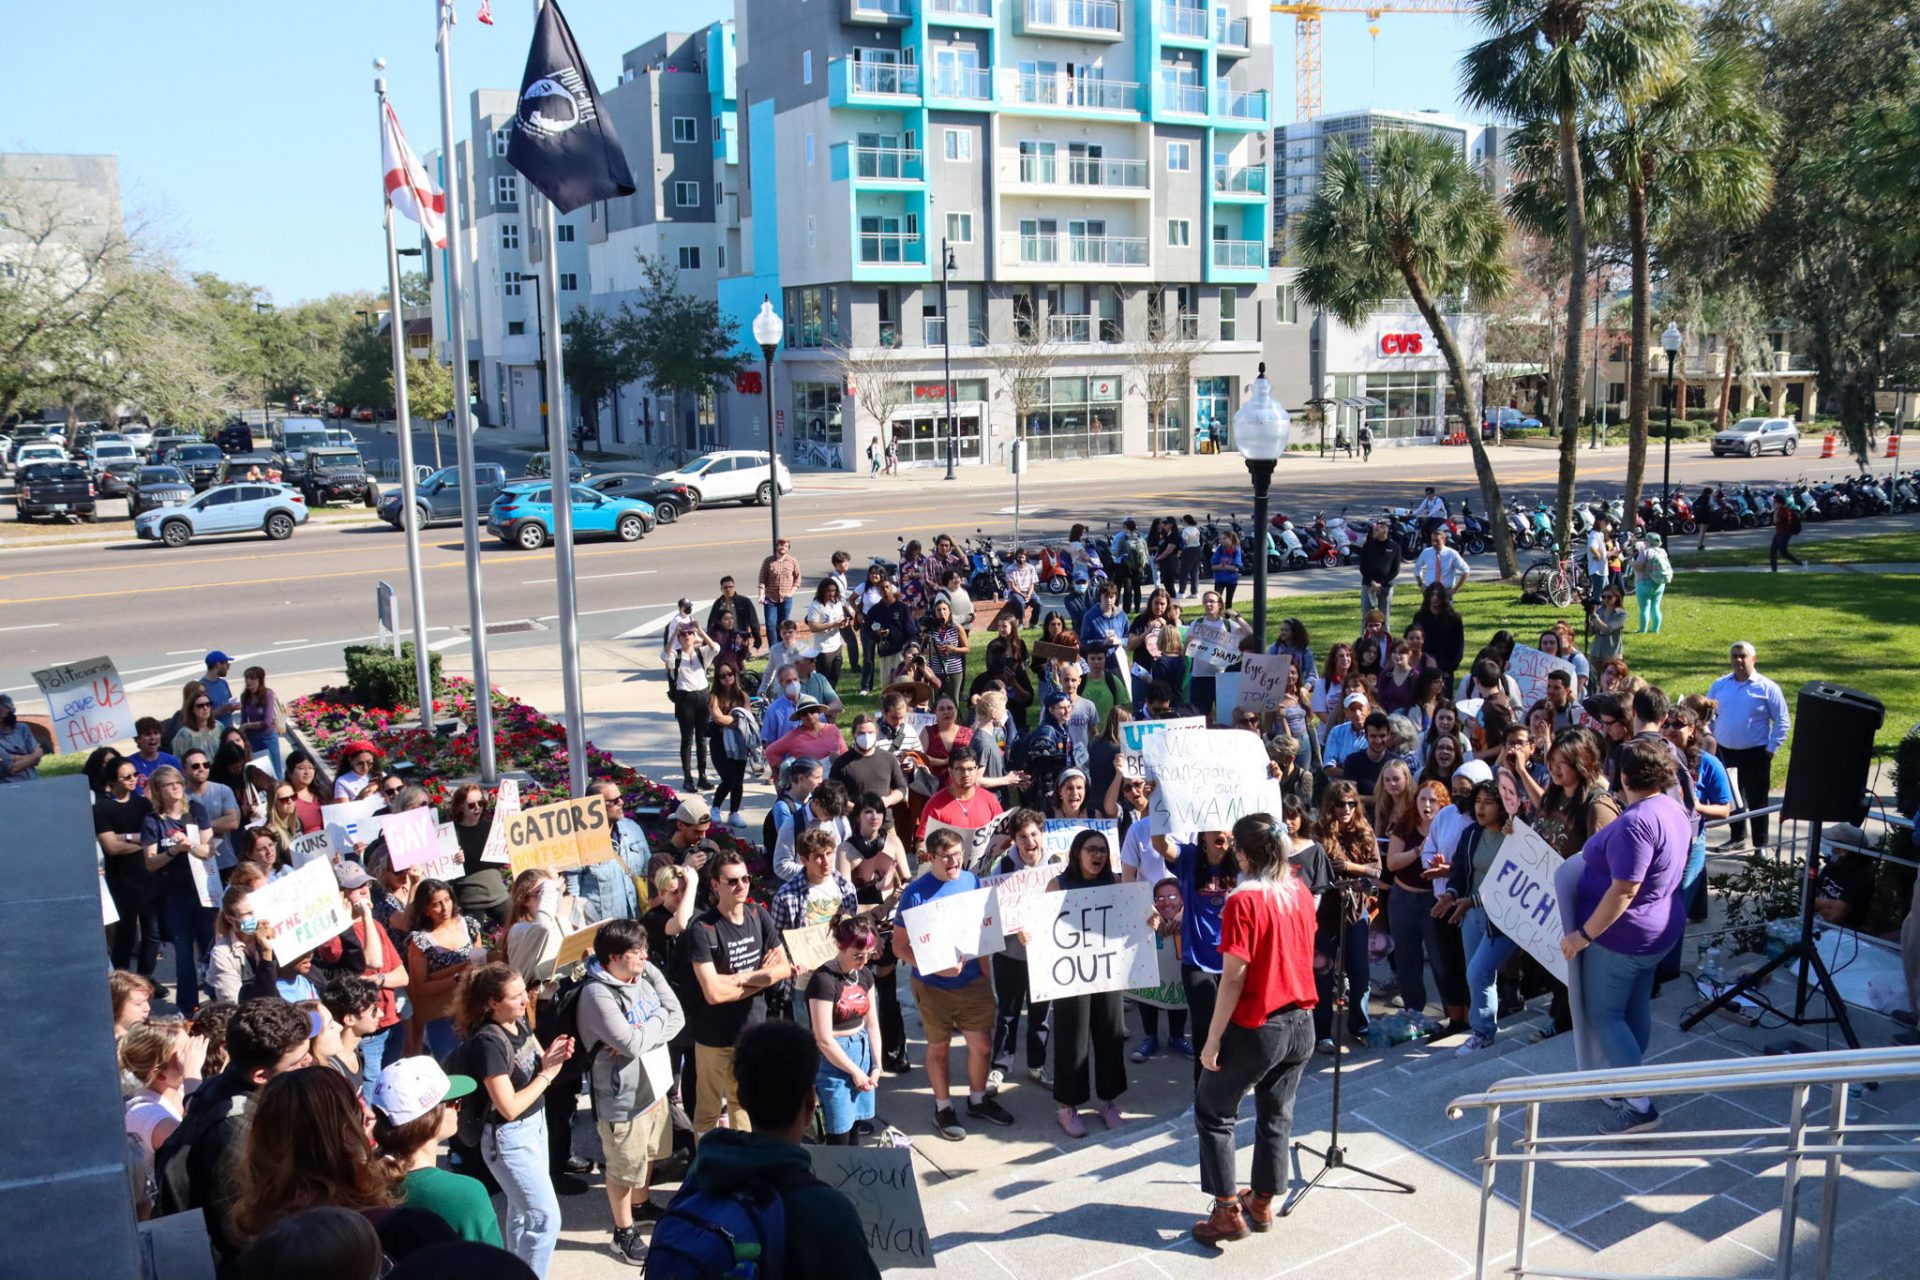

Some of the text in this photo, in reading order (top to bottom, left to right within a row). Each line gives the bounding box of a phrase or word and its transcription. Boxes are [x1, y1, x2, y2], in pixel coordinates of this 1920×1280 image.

[1381, 333, 1423, 355] CVS
[736, 371, 762, 394] CVS
[1245, 658, 1263, 680] bye
[1261, 674, 1281, 691] bye
[45, 691, 95, 722] Leave
[67, 716, 118, 751] Alone
[389, 816, 430, 857] GAY
[510, 799, 604, 847] GATORS
[295, 833, 328, 854] GUNS
[1053, 905, 1113, 949] GET
[1488, 890, 1561, 964] SUCKS
[1052, 951, 1117, 986] OUT
